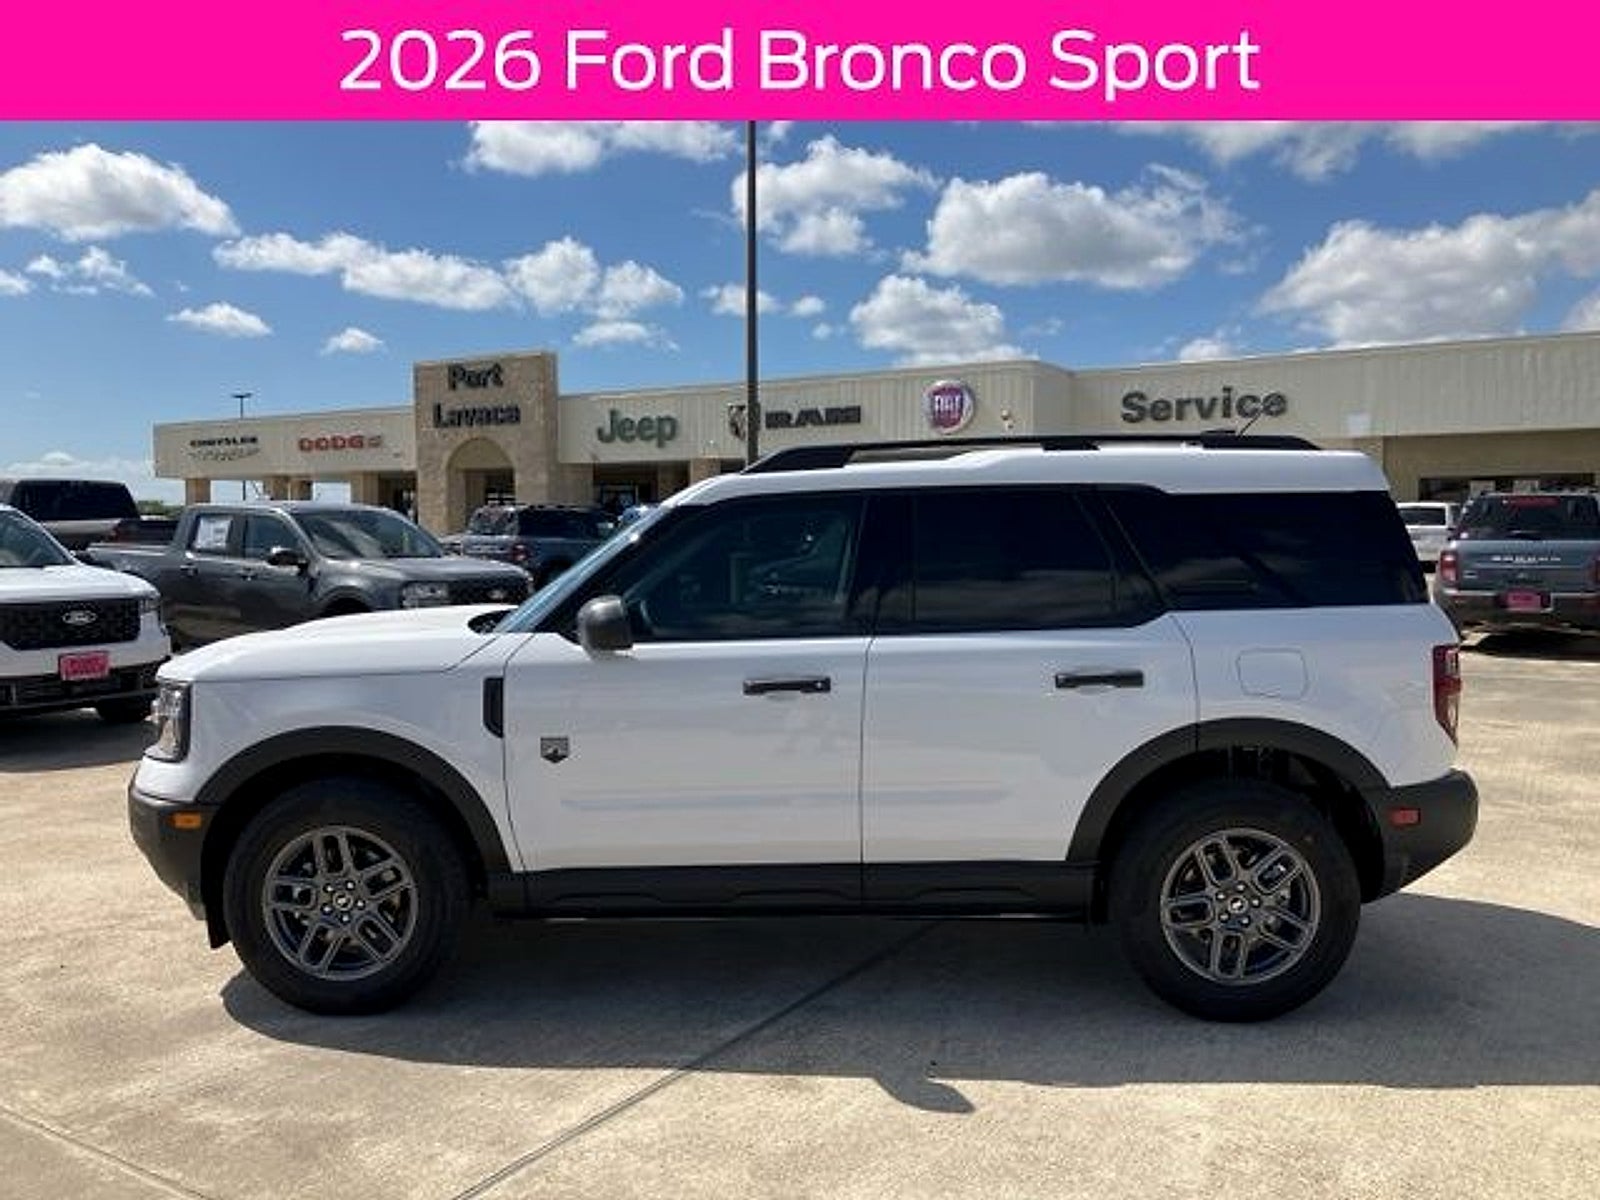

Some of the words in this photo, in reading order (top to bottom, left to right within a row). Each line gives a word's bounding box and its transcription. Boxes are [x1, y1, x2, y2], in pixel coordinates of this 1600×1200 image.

[765, 405, 861, 430] RAM
[1121, 385, 1287, 423] Service
[597, 408, 678, 448] Jeep
